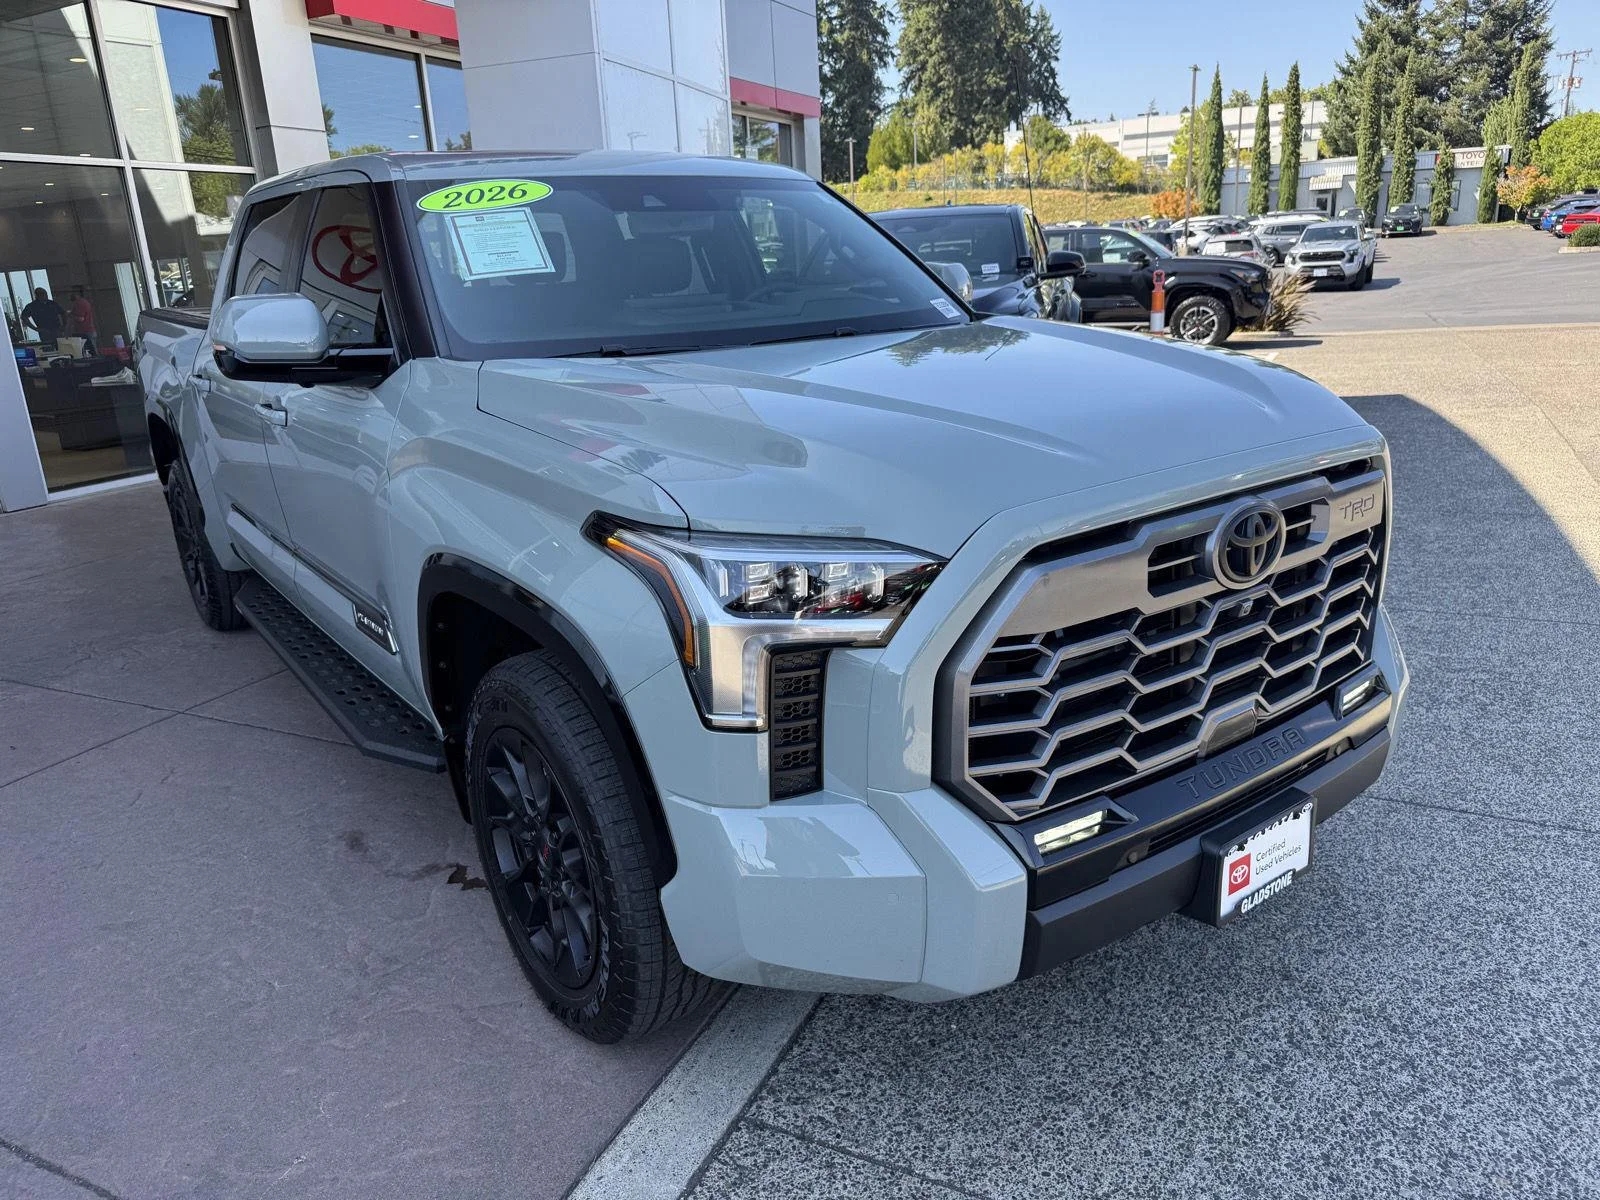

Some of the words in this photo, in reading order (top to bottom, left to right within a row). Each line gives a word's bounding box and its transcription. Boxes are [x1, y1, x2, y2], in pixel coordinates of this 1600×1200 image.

[1461, 151, 1485, 159] TOYO
[443, 183, 529, 209] 2026
[1338, 493, 1375, 521] TRD
[1175, 727, 1305, 799] TUNDRA
[1255, 861, 1273, 875] Used
[1274, 844, 1302, 865] Vehicles
[1256, 838, 1286, 862] Certified
[1241, 870, 1294, 914] GLADSTONE
